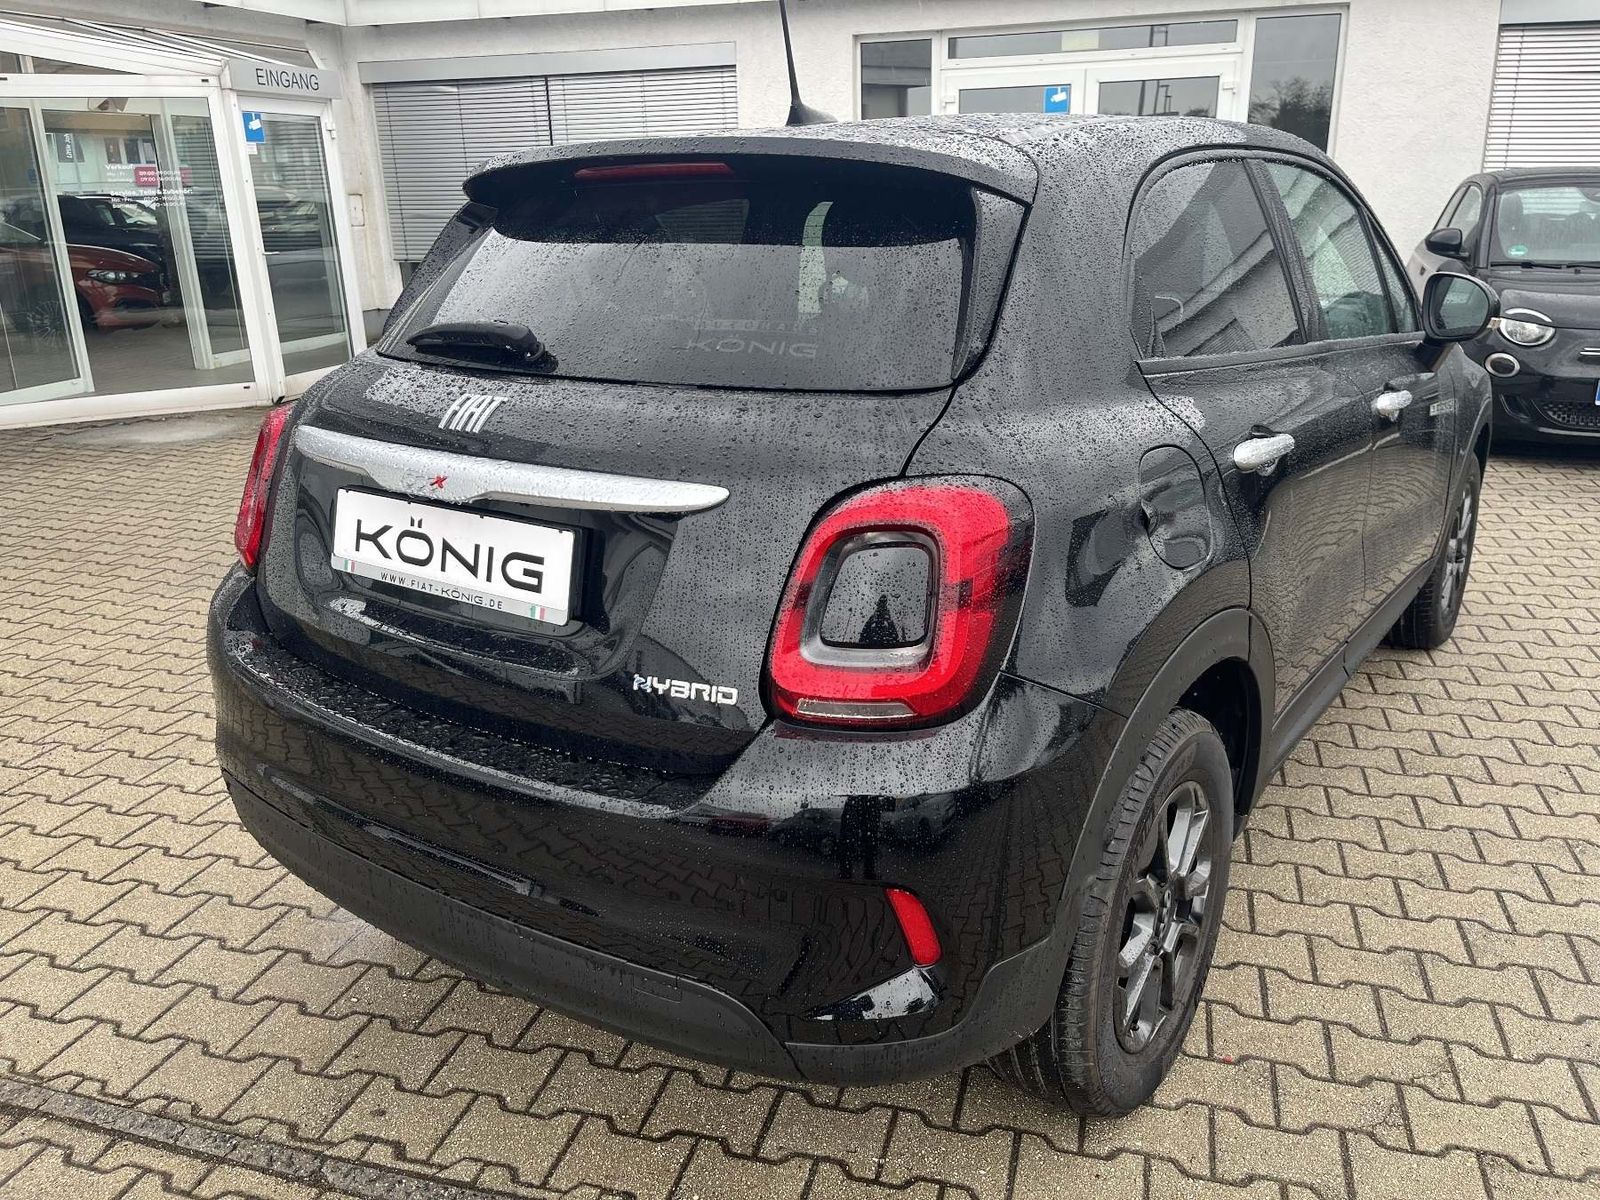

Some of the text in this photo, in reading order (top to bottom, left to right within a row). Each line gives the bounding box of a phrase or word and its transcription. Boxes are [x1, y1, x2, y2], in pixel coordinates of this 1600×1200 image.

[255, 68, 320, 91] EINGANG
[438, 393, 509, 433] FIAT
[354, 515, 546, 594] KÖNIG
[632, 673, 739, 706] HYBRID
